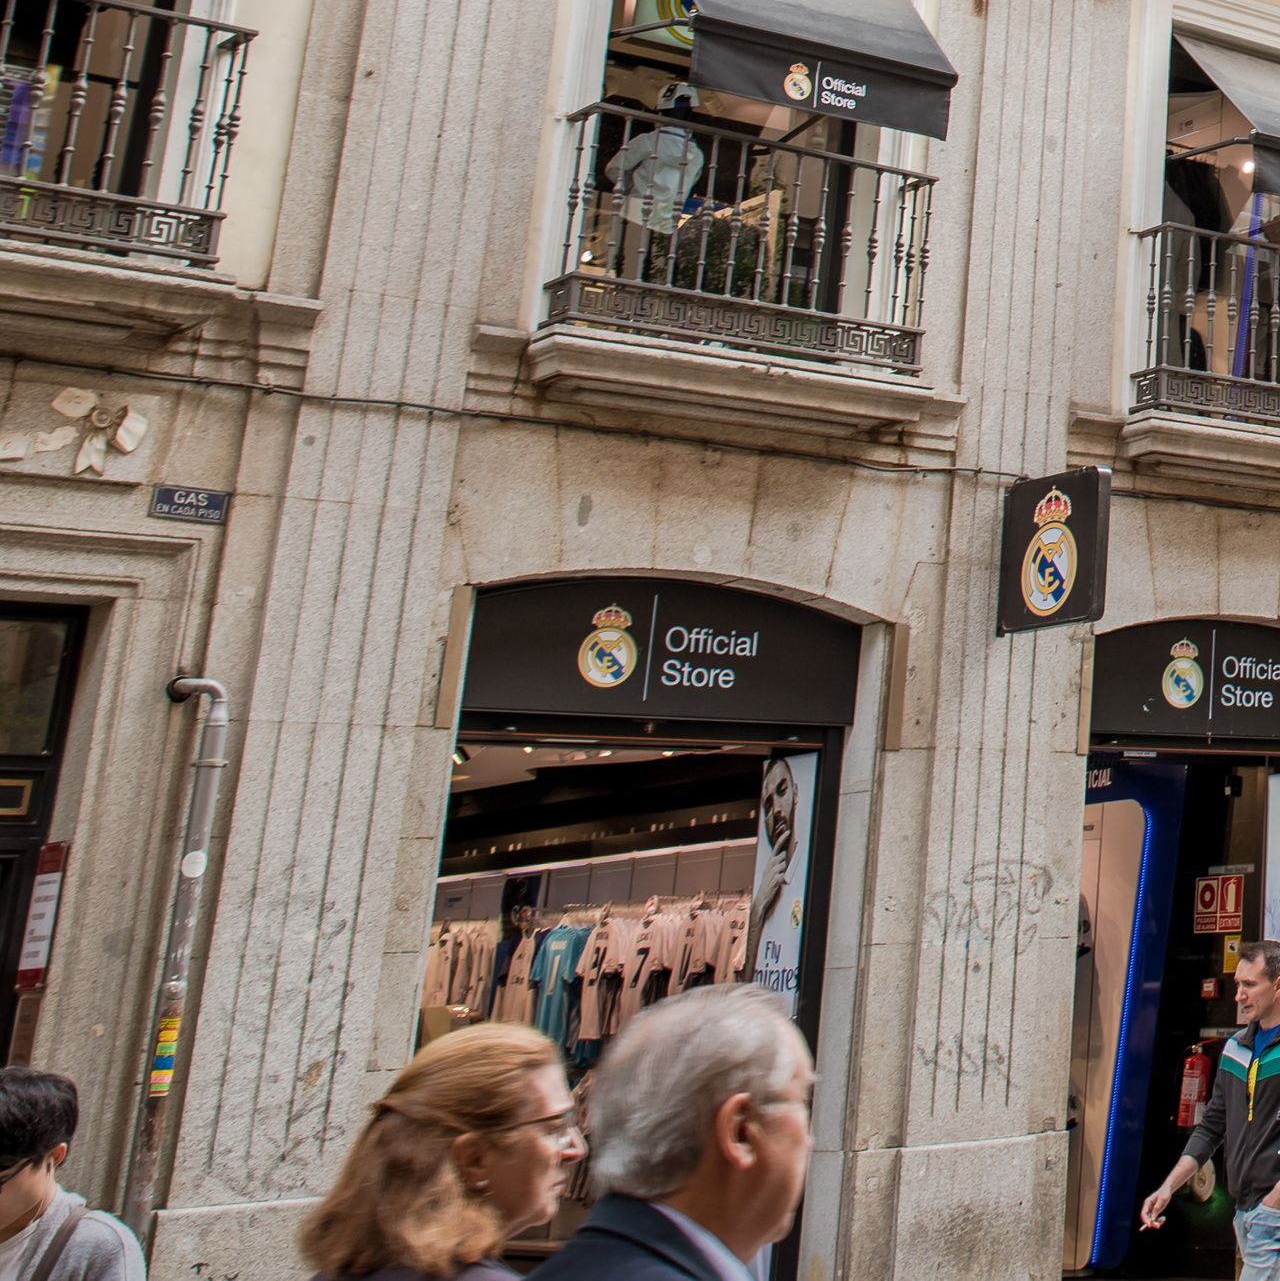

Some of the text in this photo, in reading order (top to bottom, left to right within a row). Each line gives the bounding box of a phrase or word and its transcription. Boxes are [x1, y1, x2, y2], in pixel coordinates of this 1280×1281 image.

[822, 76, 867, 98] Official
[821, 91, 857, 110] Store
[156, 503, 221, 519] EN CADA PISO
[173, 491, 209, 507] GAS
[664, 625, 760, 657] Official
[660, 659, 736, 689] Store
[1220, 683, 1274, 709] Store
[1087, 767, 1113, 789] ICIAL
[764, 940, 782, 964] Fly
[630, 947, 651, 988] 7
[754, 963, 800, 993] mirates
